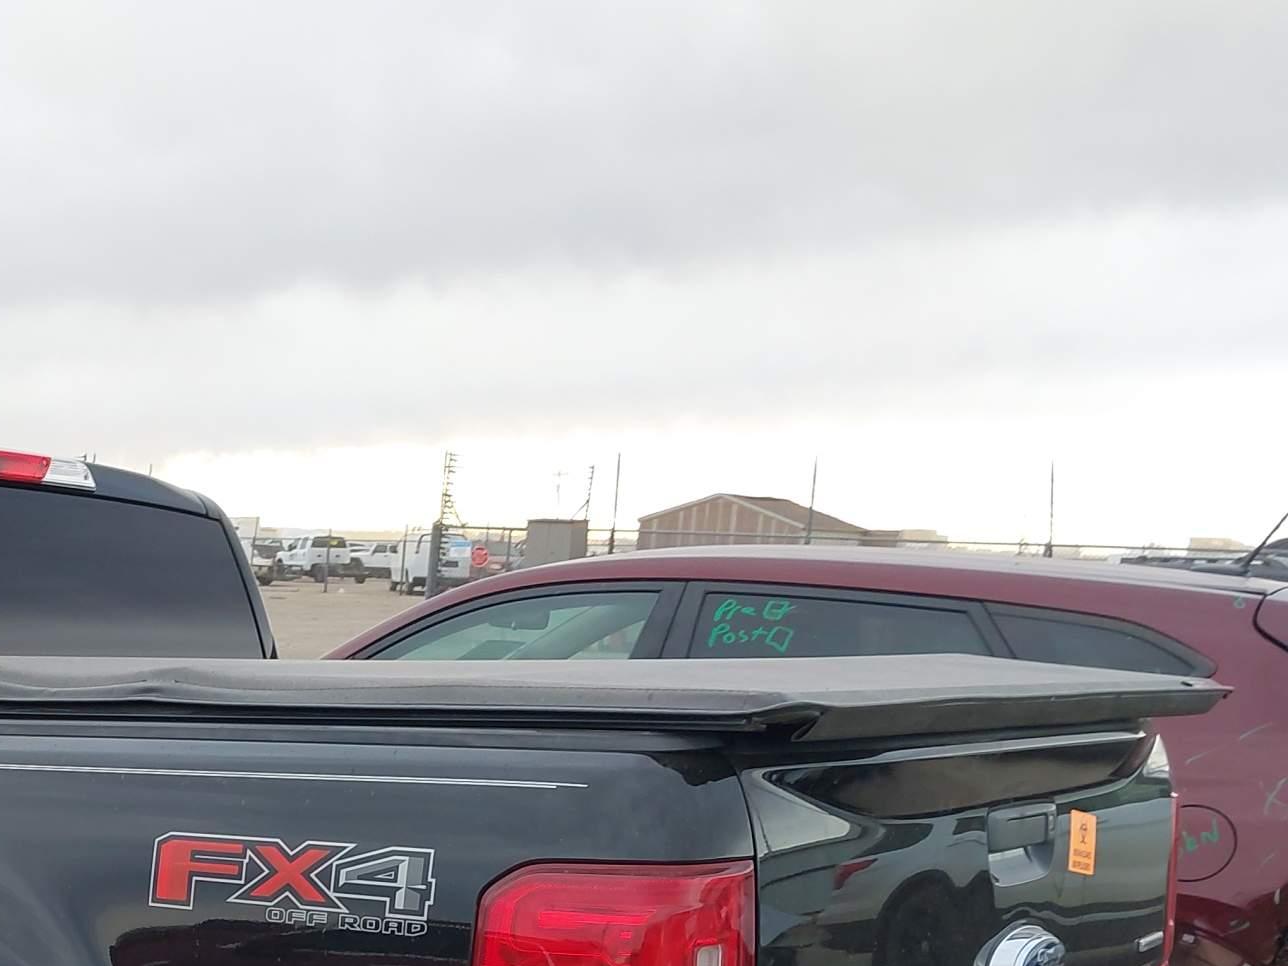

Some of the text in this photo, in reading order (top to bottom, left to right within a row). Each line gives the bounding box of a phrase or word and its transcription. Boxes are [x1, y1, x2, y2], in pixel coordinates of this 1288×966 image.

[713, 599, 757, 621] Pre
[708, 623, 768, 647] Post
[149, 831, 436, 920] FX4
[265, 907, 427, 937] OFF ROAD
